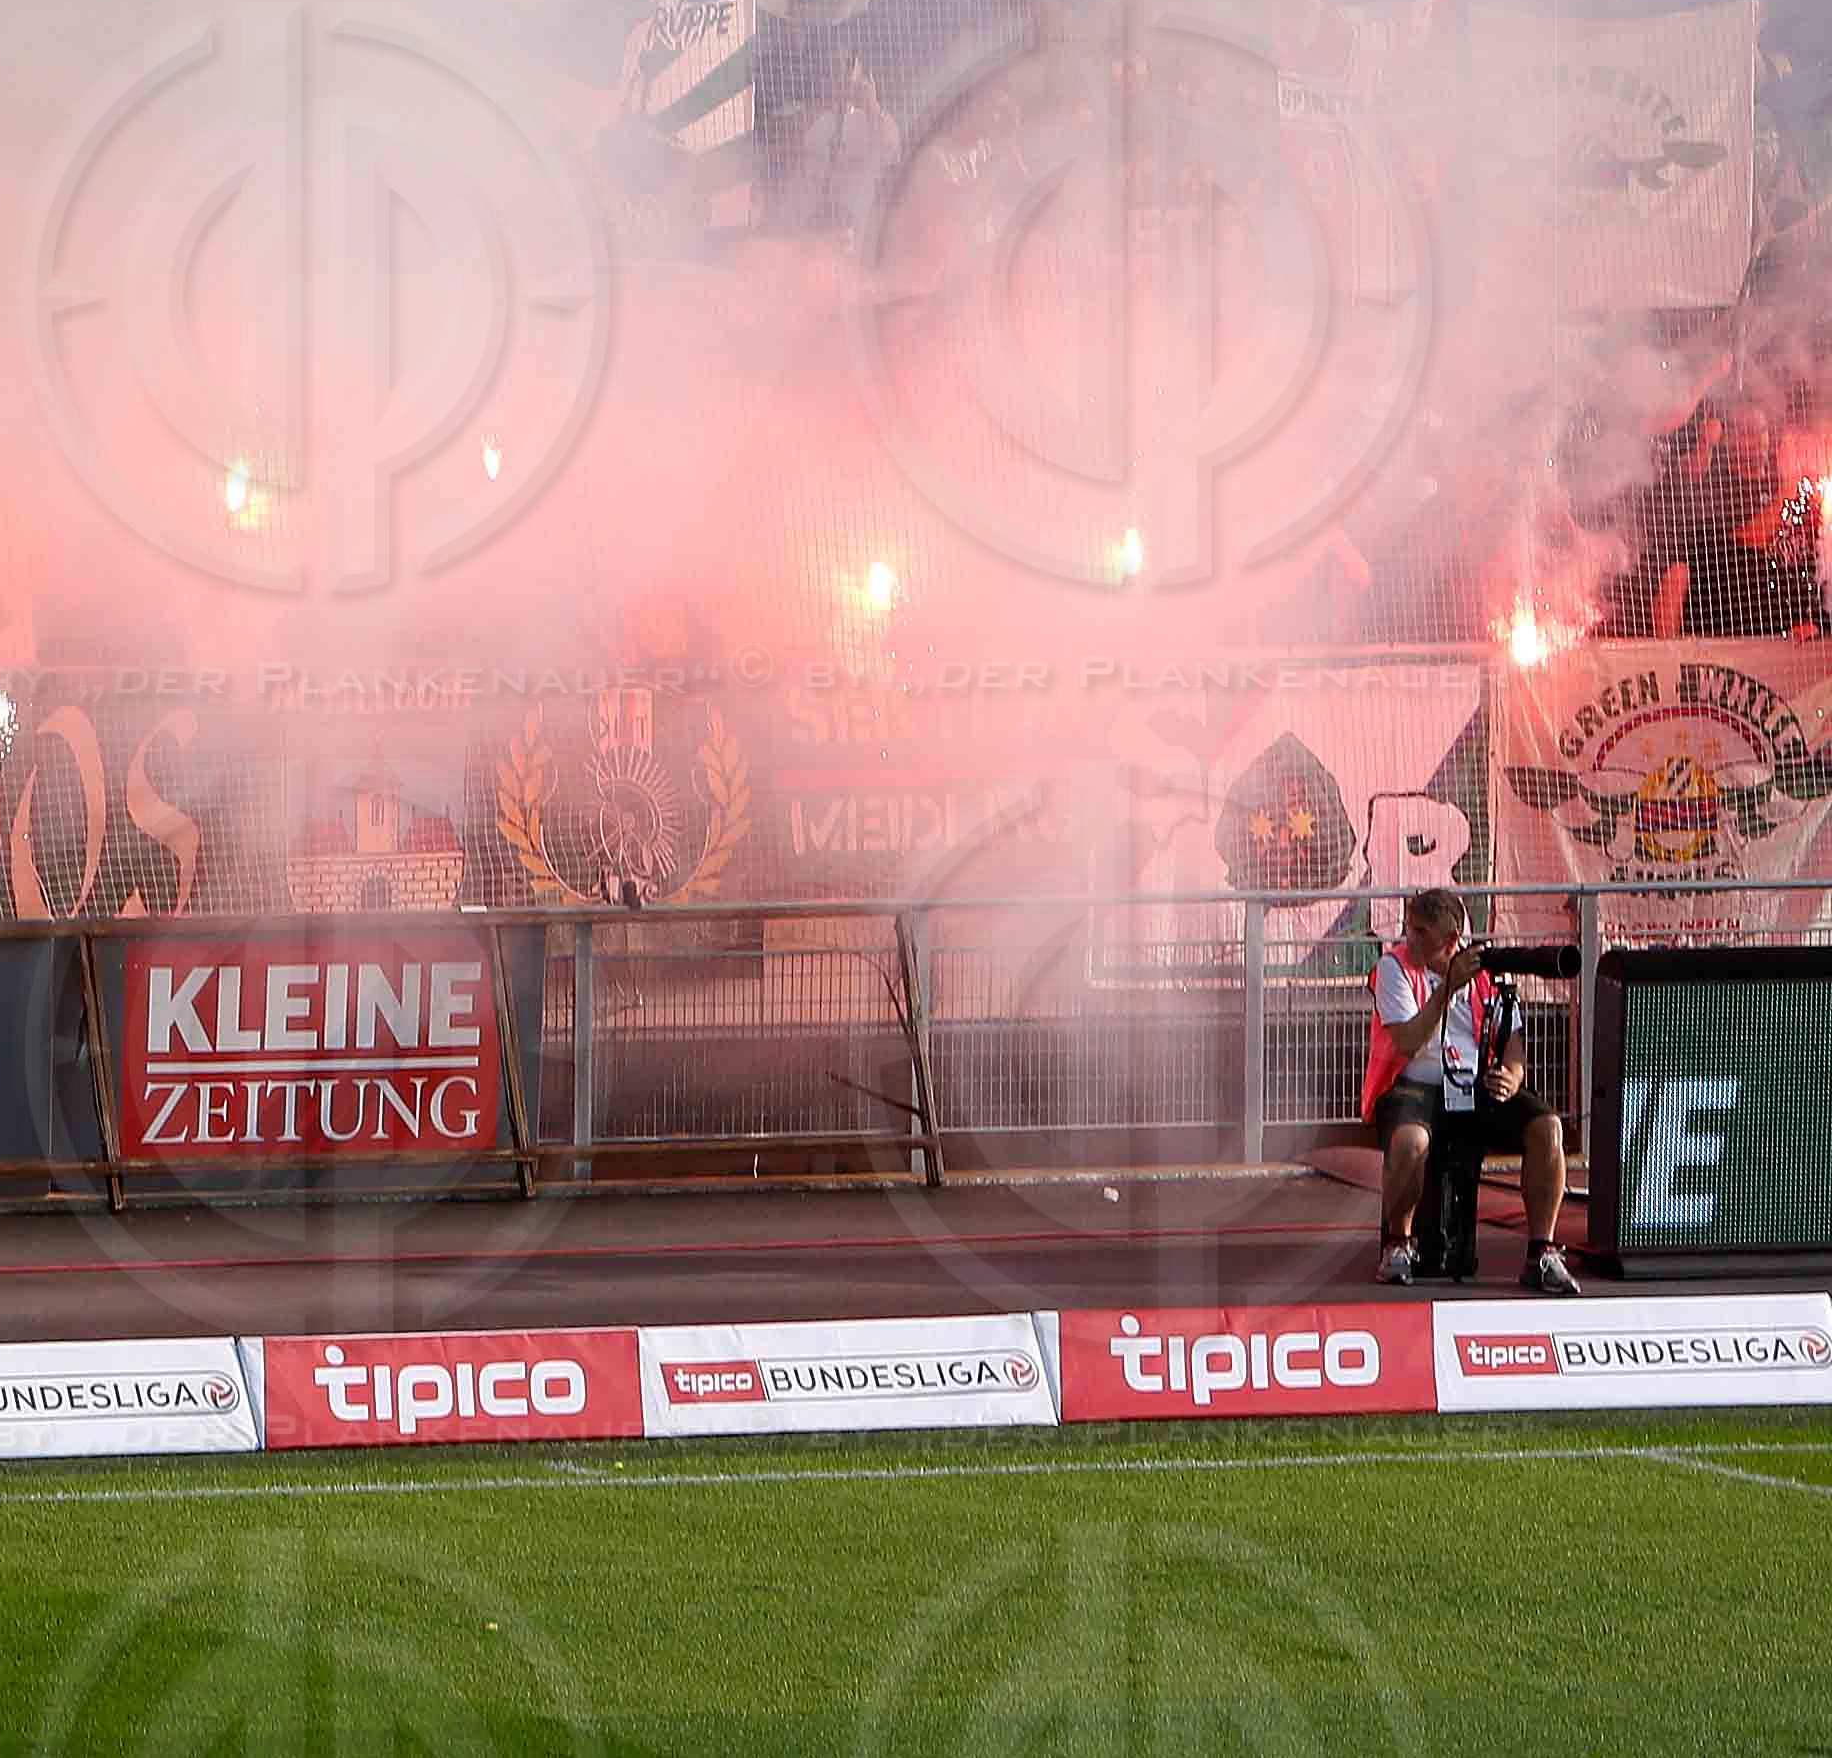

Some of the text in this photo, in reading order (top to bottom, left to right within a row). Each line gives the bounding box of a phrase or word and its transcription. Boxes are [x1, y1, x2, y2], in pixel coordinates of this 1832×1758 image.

[144, 960, 482, 1053] KLEINE
[140, 1076, 483, 1145] ZEITUNG
[313, 1344, 587, 1435] tipico
[673, 1356, 1000, 1398] tipico BUNDESLIGA
[1109, 1312, 1381, 1406] tipico
[1466, 1336, 1793, 1371] tipico BUNDESLIGA
